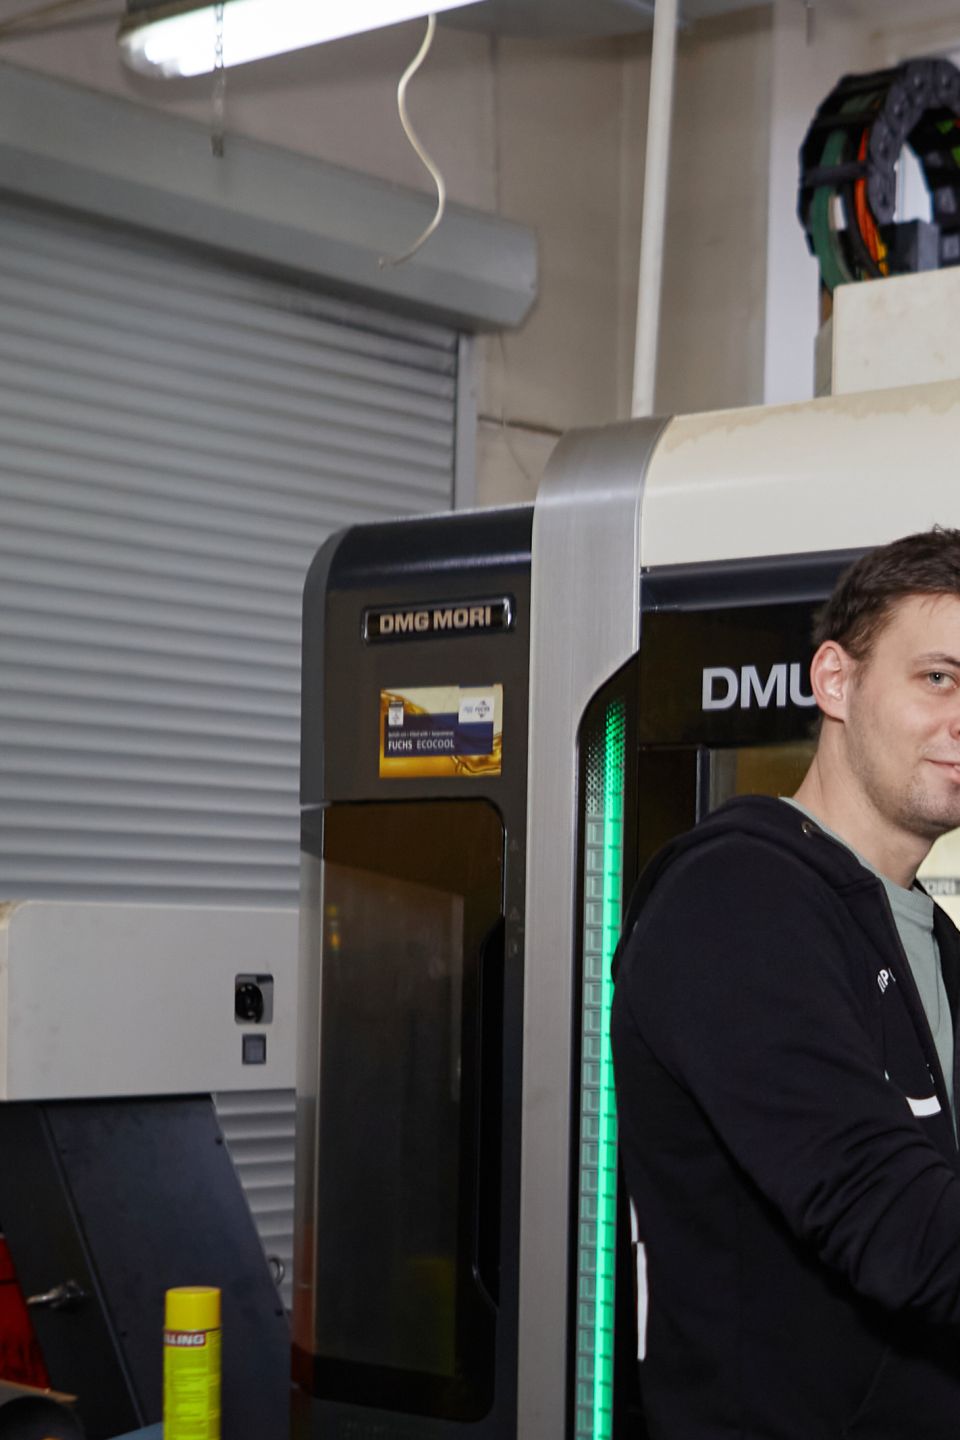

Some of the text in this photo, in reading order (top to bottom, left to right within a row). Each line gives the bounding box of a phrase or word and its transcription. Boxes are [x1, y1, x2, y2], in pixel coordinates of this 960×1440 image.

[379, 606, 491, 635] DMG MORI
[702, 662, 817, 711] DMU
[388, 739, 455, 751] FUCHS ECOCOOL
